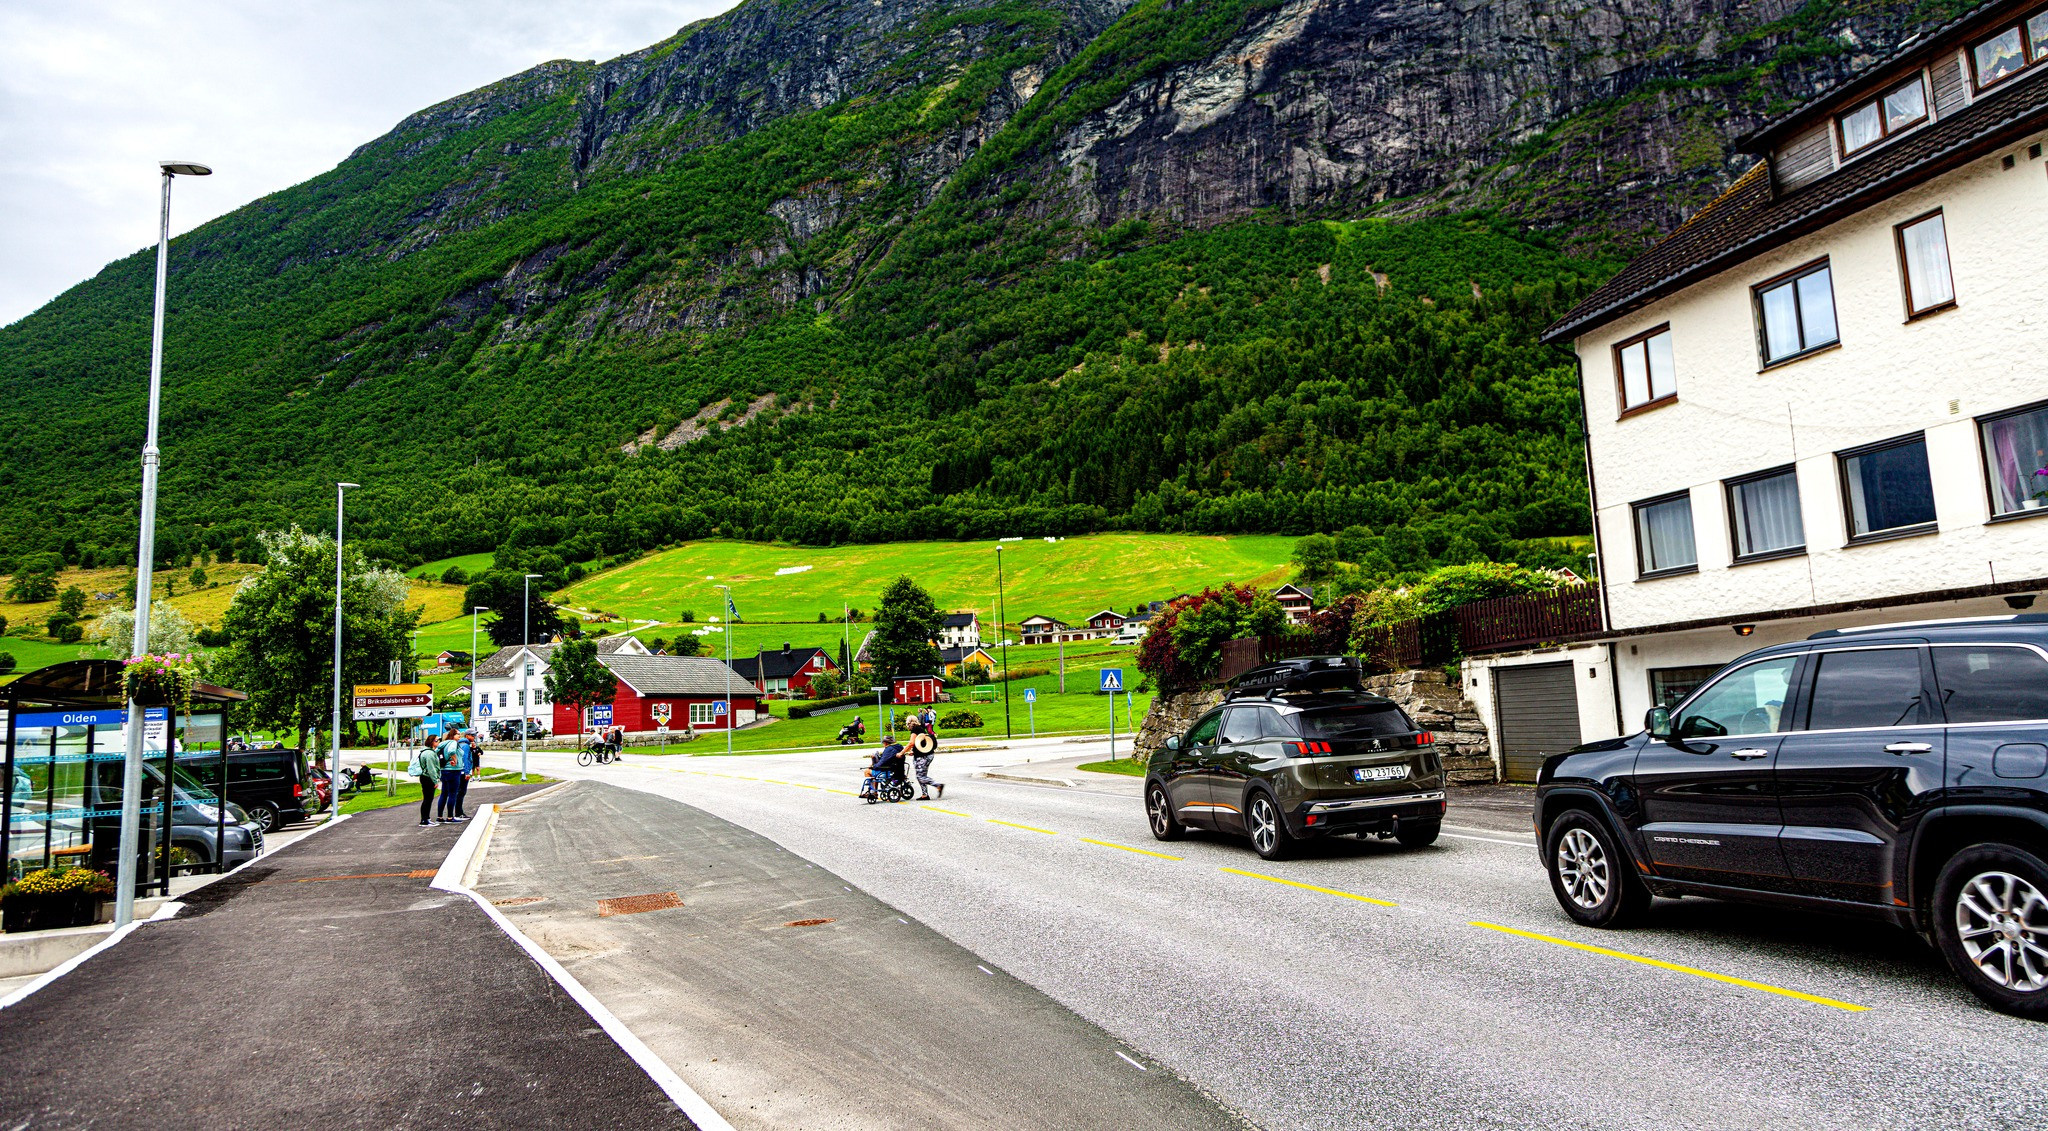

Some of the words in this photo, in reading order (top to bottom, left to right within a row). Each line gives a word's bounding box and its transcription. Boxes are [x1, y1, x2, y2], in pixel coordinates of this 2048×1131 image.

[367, 697, 413, 705] Briksdalsbreen
[62, 713, 97, 724] Olden
[1361, 768, 1373, 778] ZD
[1376, 766, 1402, 777] 23766
[1679, 838, 1721, 846] CHEROKEE
